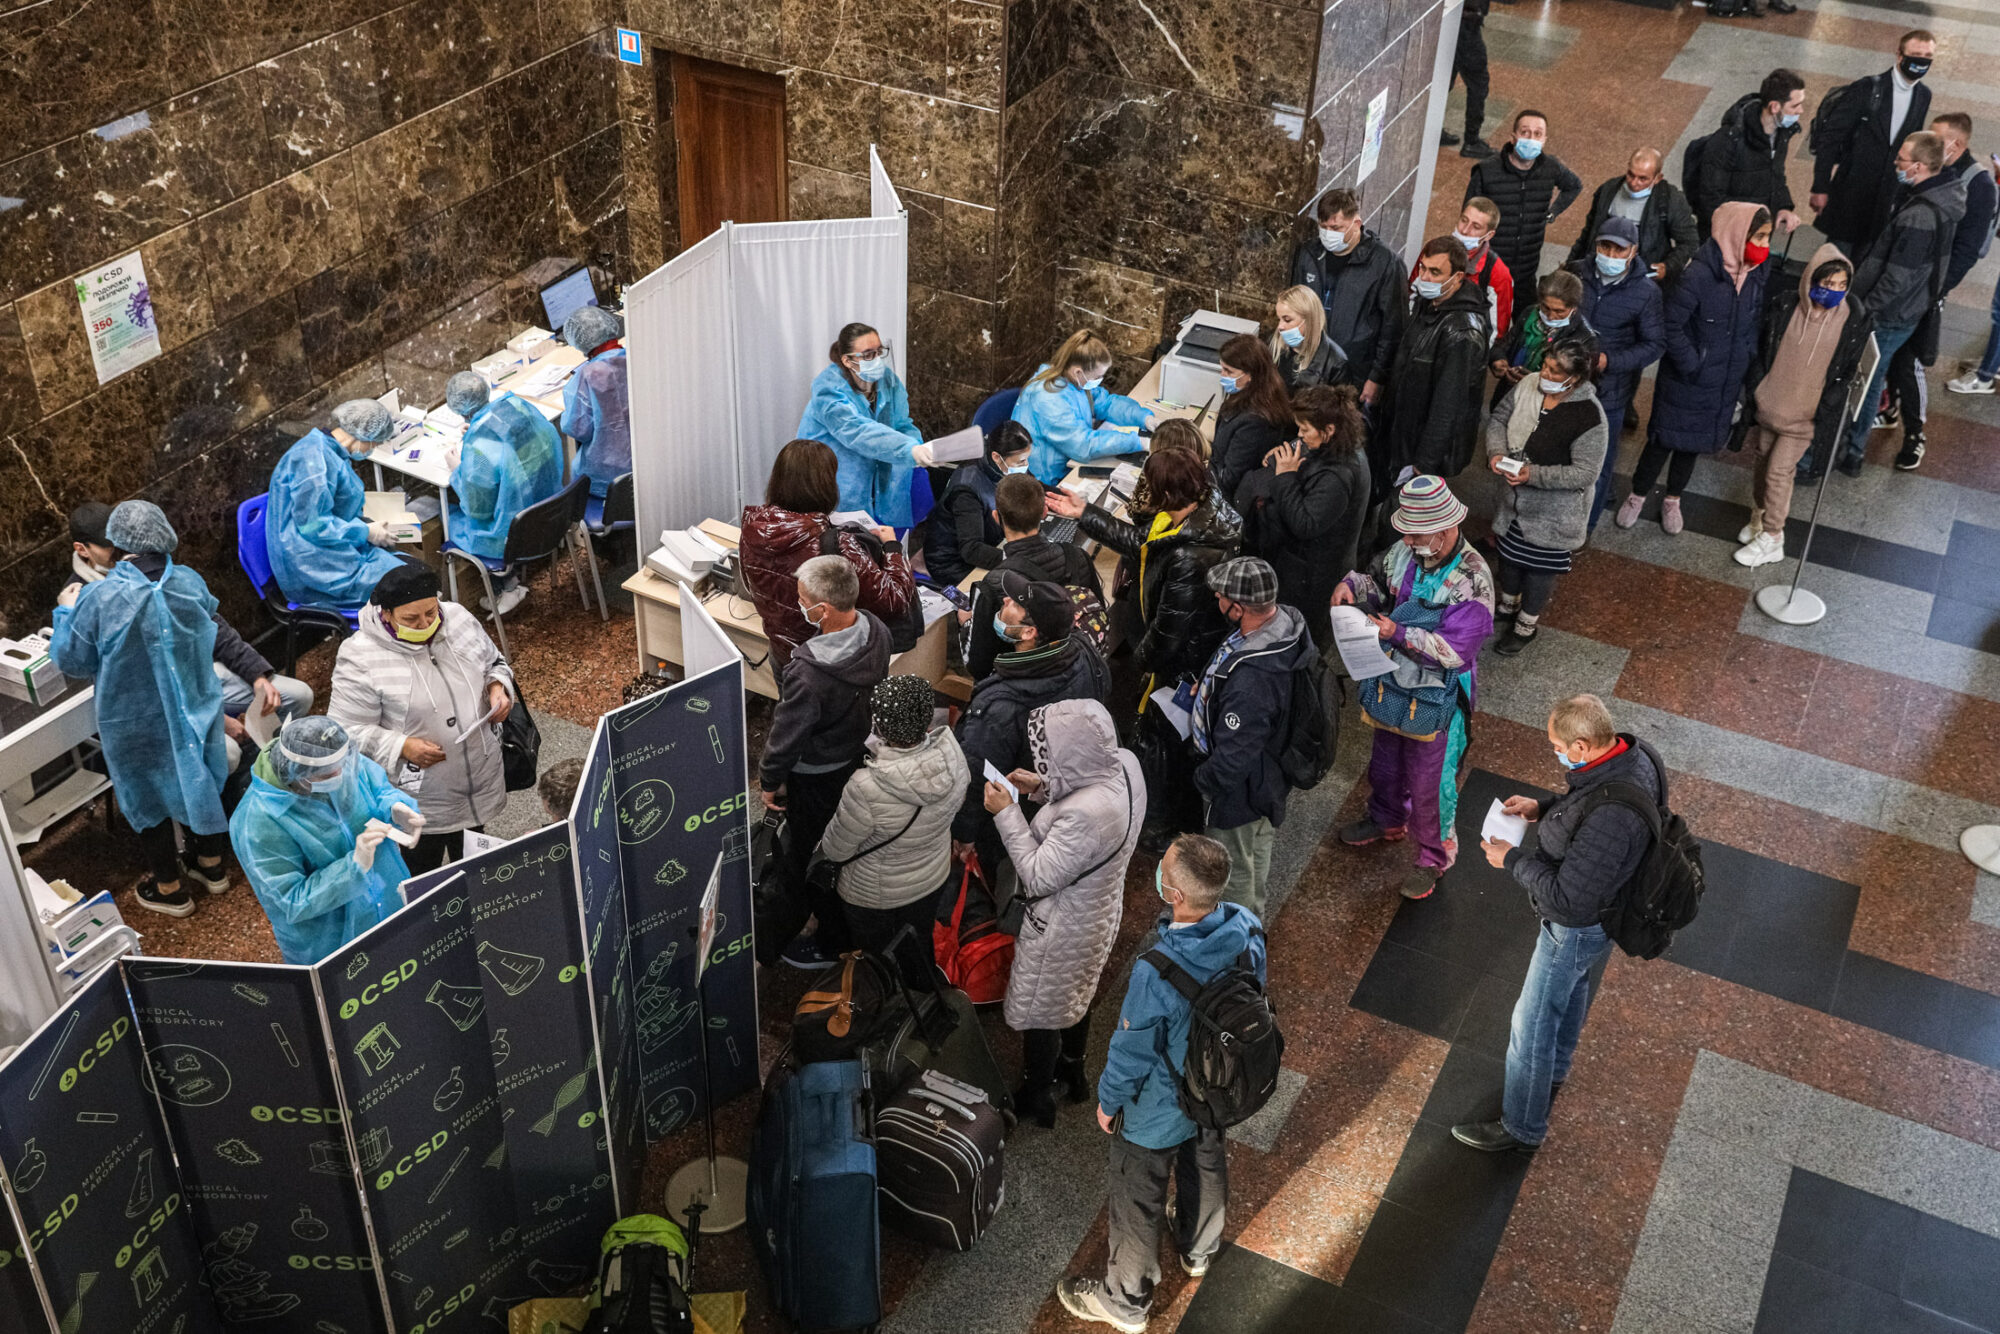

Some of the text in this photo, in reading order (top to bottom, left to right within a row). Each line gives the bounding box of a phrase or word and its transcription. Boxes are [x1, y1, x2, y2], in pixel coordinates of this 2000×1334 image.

[103, 267, 123, 281] CSD
[93, 317, 113, 333] 350
[613, 743, 655, 765] MEDICAL
[614, 742, 677, 774] LABORATORY
[703, 792, 747, 823] CSD
[629, 909, 668, 931] MEDICAL
[630, 906, 688, 939] LABORATORY
[422, 925, 466, 956] MEDICAL
[712, 933, 753, 964] CSD
[361, 959, 418, 1005] CSD
[78, 1016, 130, 1073] CSD
[358, 1072, 402, 1106] MEDICAL
[359, 1064, 426, 1114] LABORATORY
[496, 1063, 542, 1087] MEDICAL
[498, 1060, 568, 1095] LABORATORY
[452, 1095, 492, 1127] MEDICAL
[81, 1144, 122, 1188] MEDICAL
[84, 1130, 144, 1196] LABORATORY
[396, 1130, 448, 1175] CSD
[133, 1193, 181, 1249] CSD
[389, 1219, 430, 1252] MEDICAL
[390, 1209, 452, 1260] LABORATORY
[522, 1217, 566, 1241] MEDICAL
[427, 1283, 476, 1328] CSD
